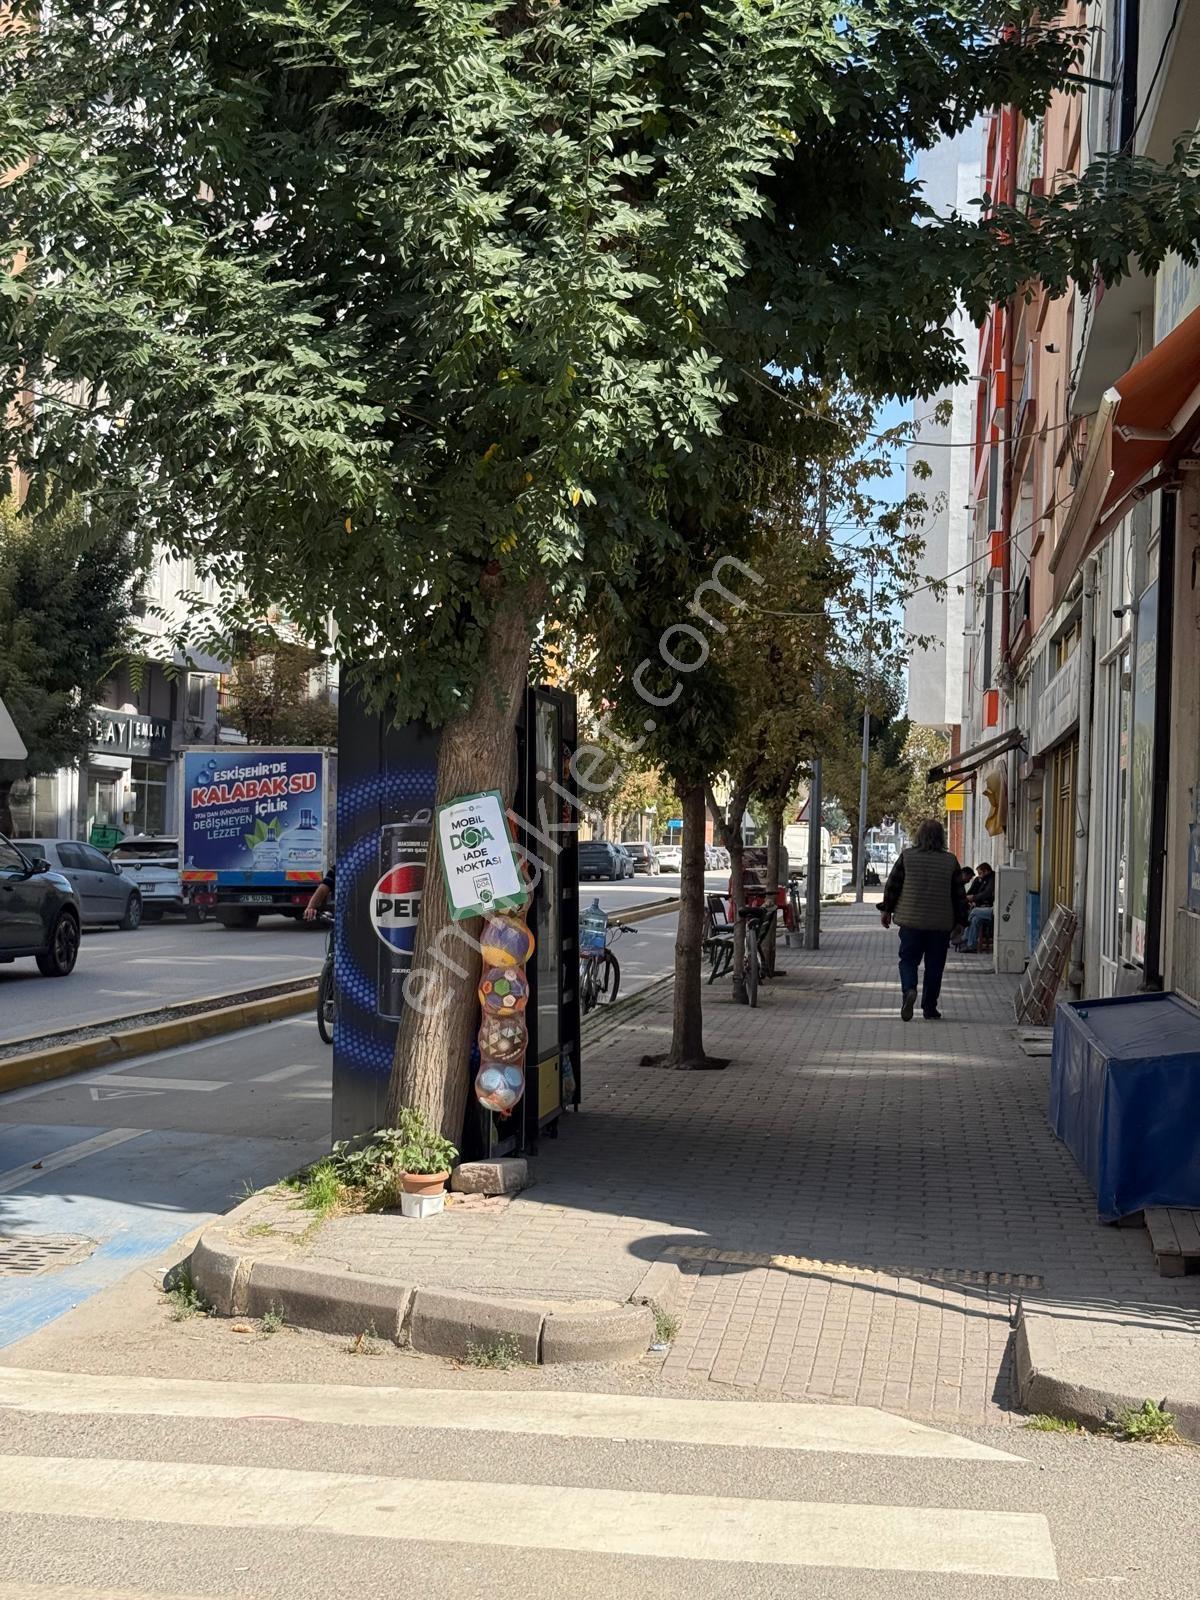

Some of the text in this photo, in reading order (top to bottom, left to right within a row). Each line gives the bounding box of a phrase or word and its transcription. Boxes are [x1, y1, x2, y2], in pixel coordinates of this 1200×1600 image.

[135, 722, 166, 738] EMLAK
[213, 762, 287, 782] ESKİŞEHİR'DE
[191, 772, 316, 808] KALABAK SU
[255, 798, 288, 817] İÇİLİR
[193, 815, 253, 831] DEĞİŞMEYEN
[207, 827, 241, 840] LEZZET
